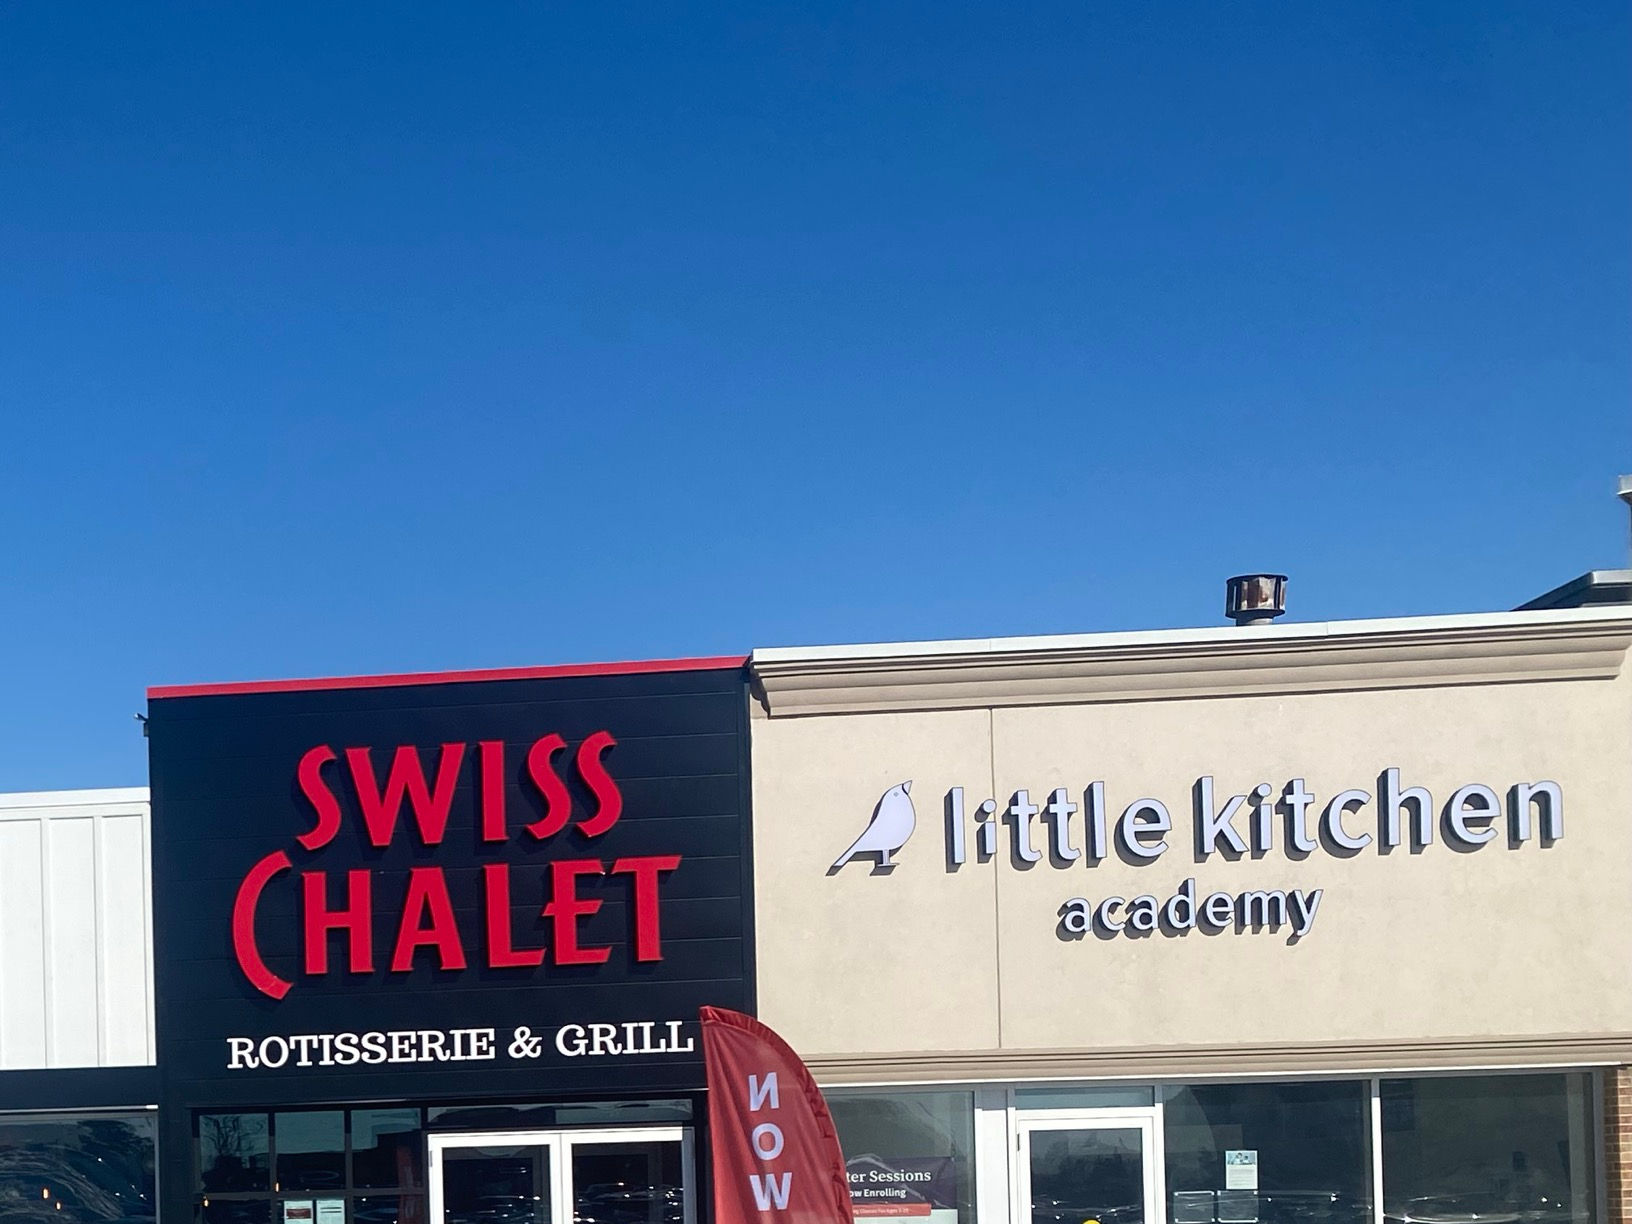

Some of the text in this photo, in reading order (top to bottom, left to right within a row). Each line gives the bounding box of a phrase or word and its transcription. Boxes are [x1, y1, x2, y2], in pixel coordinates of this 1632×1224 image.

[294, 730, 624, 851] SWISS
[946, 767, 1565, 866] little kitchen
[232, 850, 683, 1001] CHALET
[1061, 877, 1324, 938] academy
[226, 1020, 695, 1070] ROTISSERIE & GRILL
[849, 1187, 907, 1199] ow Enrolling
[869, 1169, 932, 1183] Sessions
